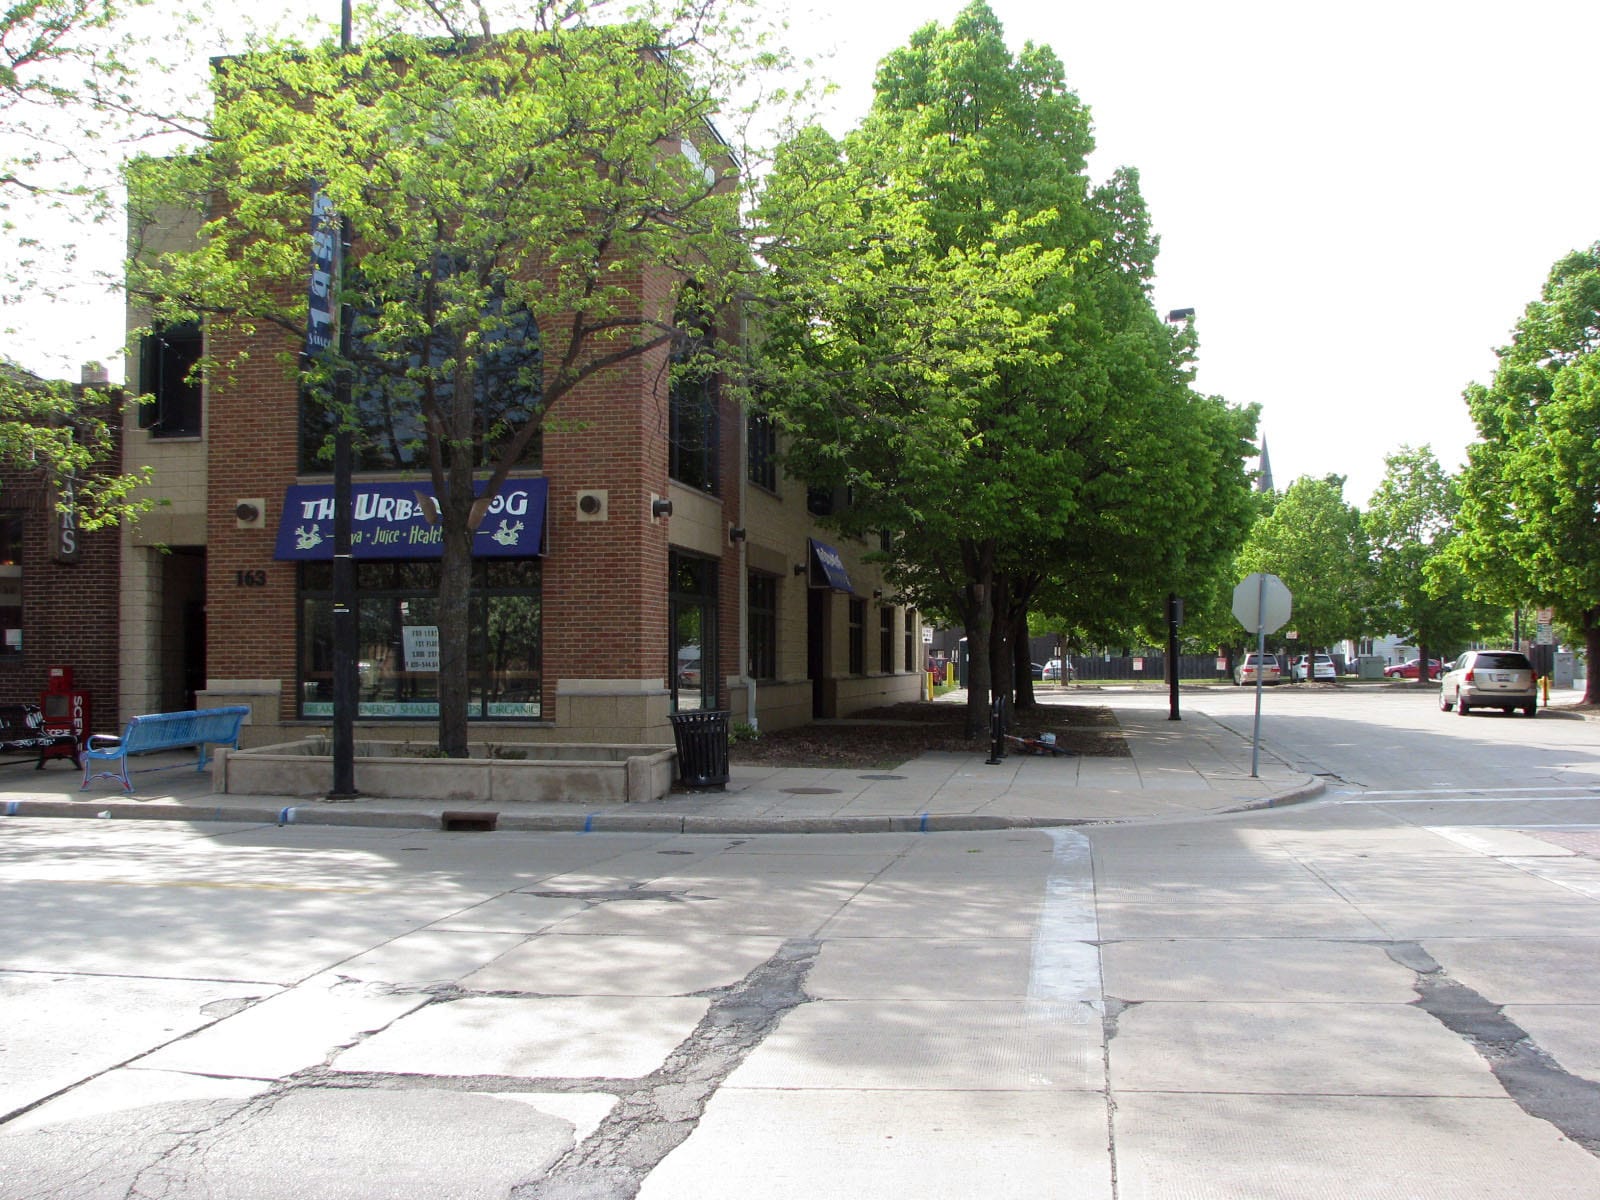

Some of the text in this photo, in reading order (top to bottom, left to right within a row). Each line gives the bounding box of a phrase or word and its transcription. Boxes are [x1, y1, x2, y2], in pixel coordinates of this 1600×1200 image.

[301, 498, 352, 520] TH
[371, 526, 400, 545] Juice
[237, 570, 266, 586] 163
[359, 702, 397, 715] ENERGY
[400, 702, 438, 715] SHAKES
[488, 703, 540, 715] ORGANIC
